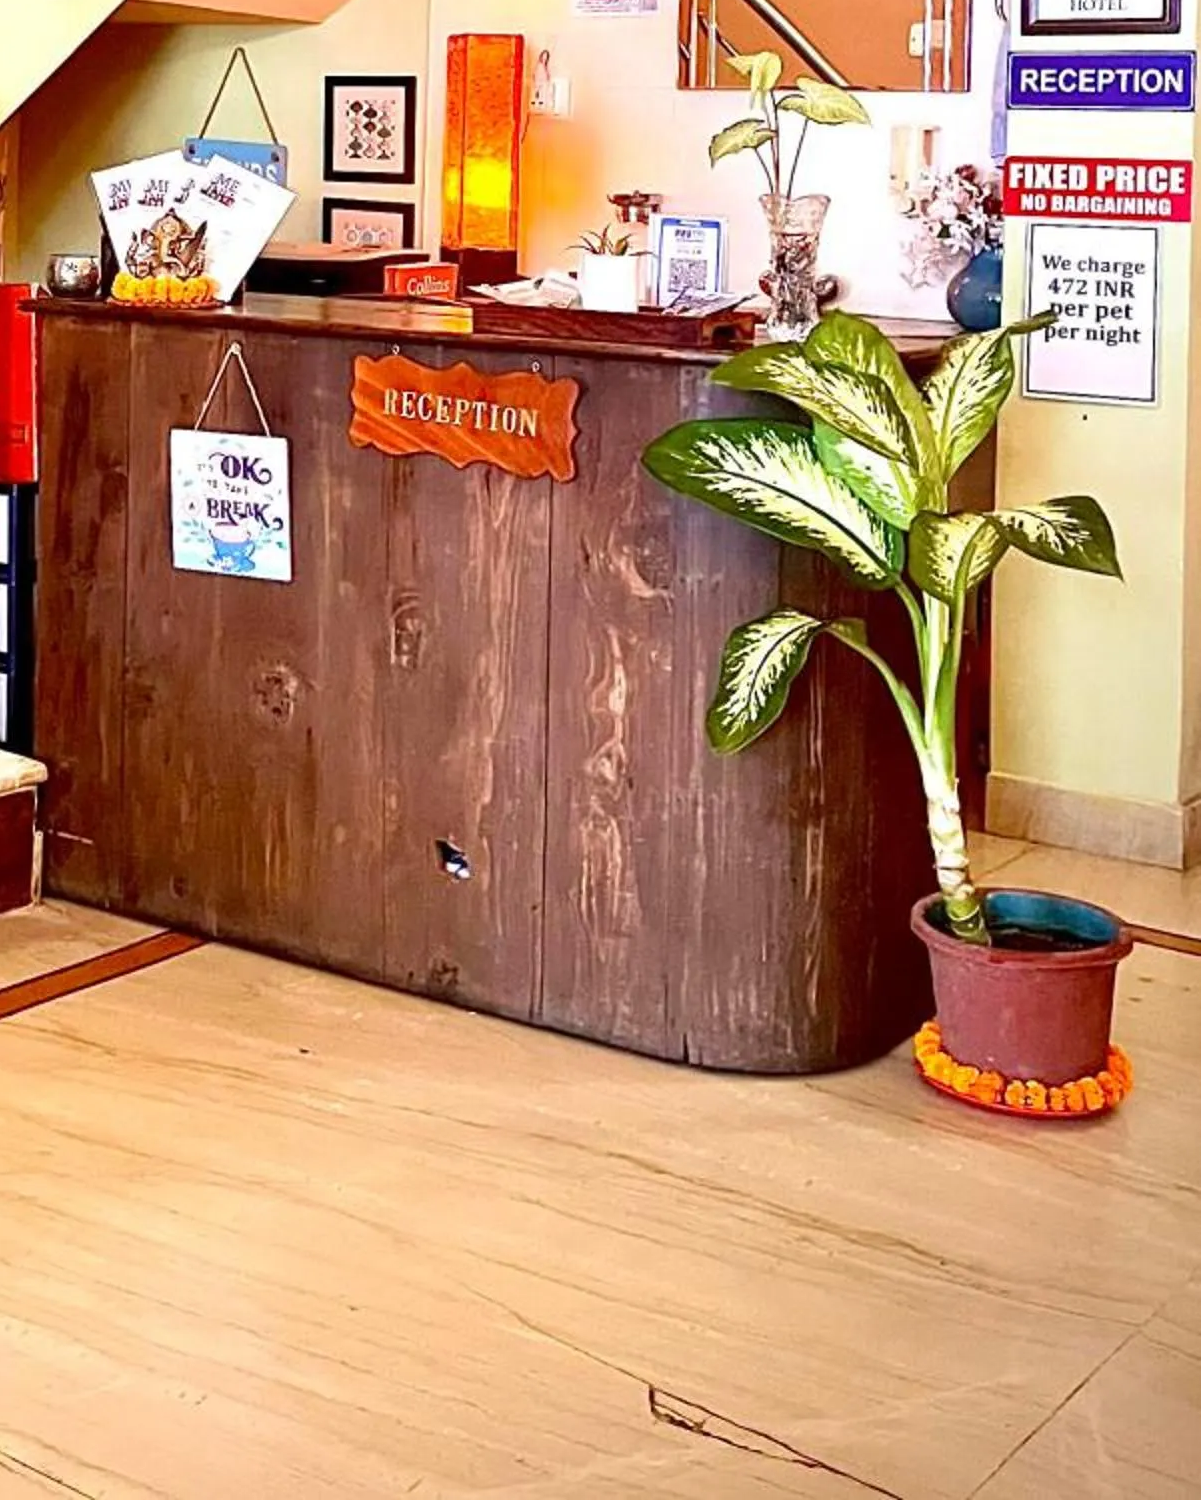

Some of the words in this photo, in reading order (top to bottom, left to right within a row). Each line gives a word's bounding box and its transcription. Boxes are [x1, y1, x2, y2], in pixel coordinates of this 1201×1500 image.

[1019, 67, 1184, 94] RECEPTION
[1008, 162, 1088, 191] FIXED
[1095, 164, 1187, 194] PRICE
[1020, 193, 1047, 211] NO
[1051, 195, 1172, 216] BARGAINING
[1042, 254, 1072, 270] We
[1077, 256, 1146, 279] charge
[406, 275, 450, 296] Collins
[1048, 277, 1088, 295] 472
[1095, 280, 1135, 298] INR
[1050, 302, 1089, 319] per
[1095, 303, 1133, 323] pet
[1044, 324, 1080, 343] per
[1086, 325, 1141, 347] night
[383, 387, 539, 438] RECEPTION
[209, 451, 272, 485] OK
[206, 497, 283, 530] BREAK
